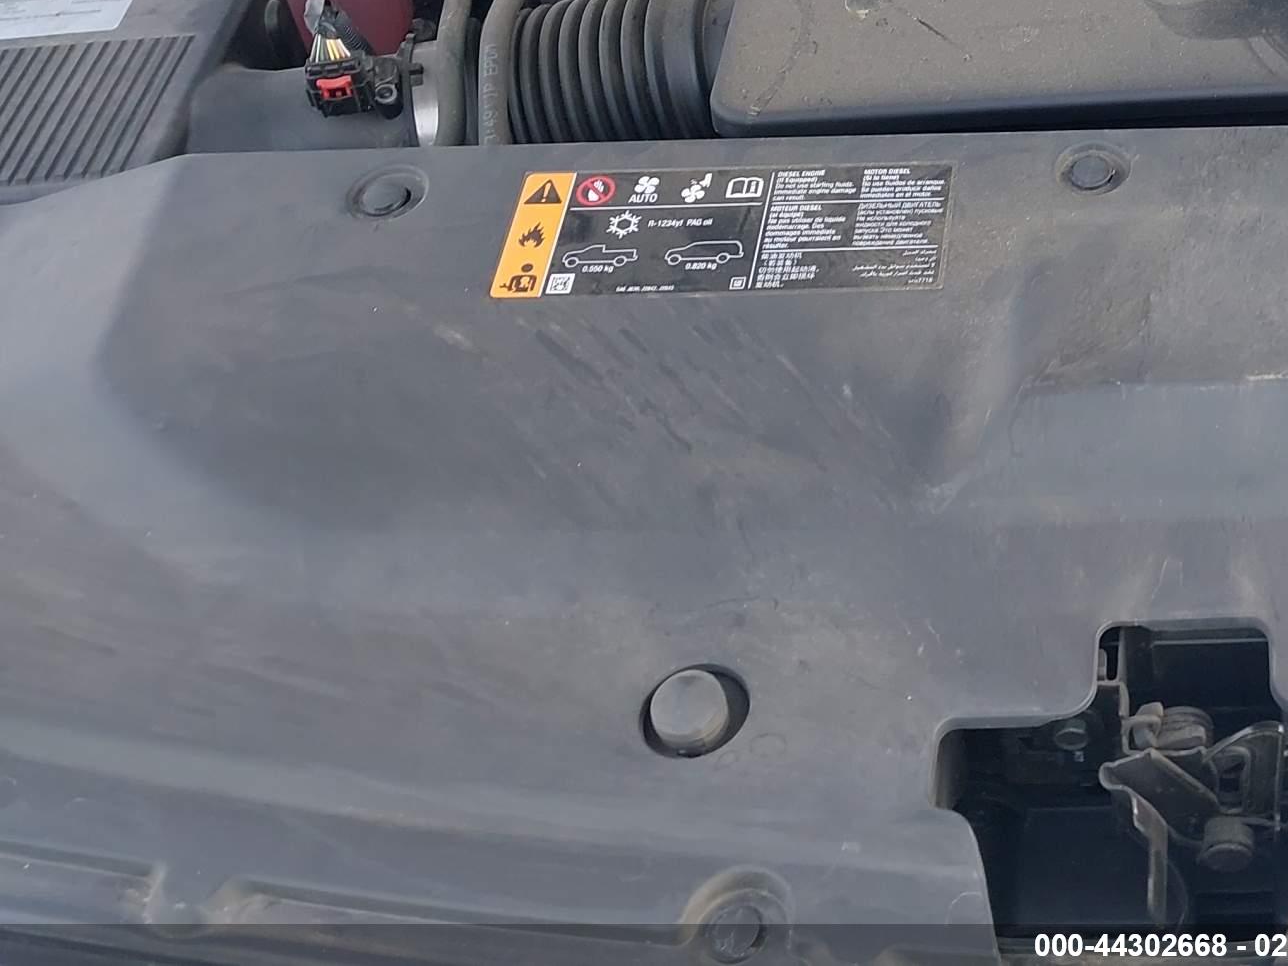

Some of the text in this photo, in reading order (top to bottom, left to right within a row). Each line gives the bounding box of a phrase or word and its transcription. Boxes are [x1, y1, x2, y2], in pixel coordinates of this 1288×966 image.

[628, 194, 658, 203] AUTO
[648, 218, 684, 228] R-1234yf
[686, 218, 702, 226] PAG
